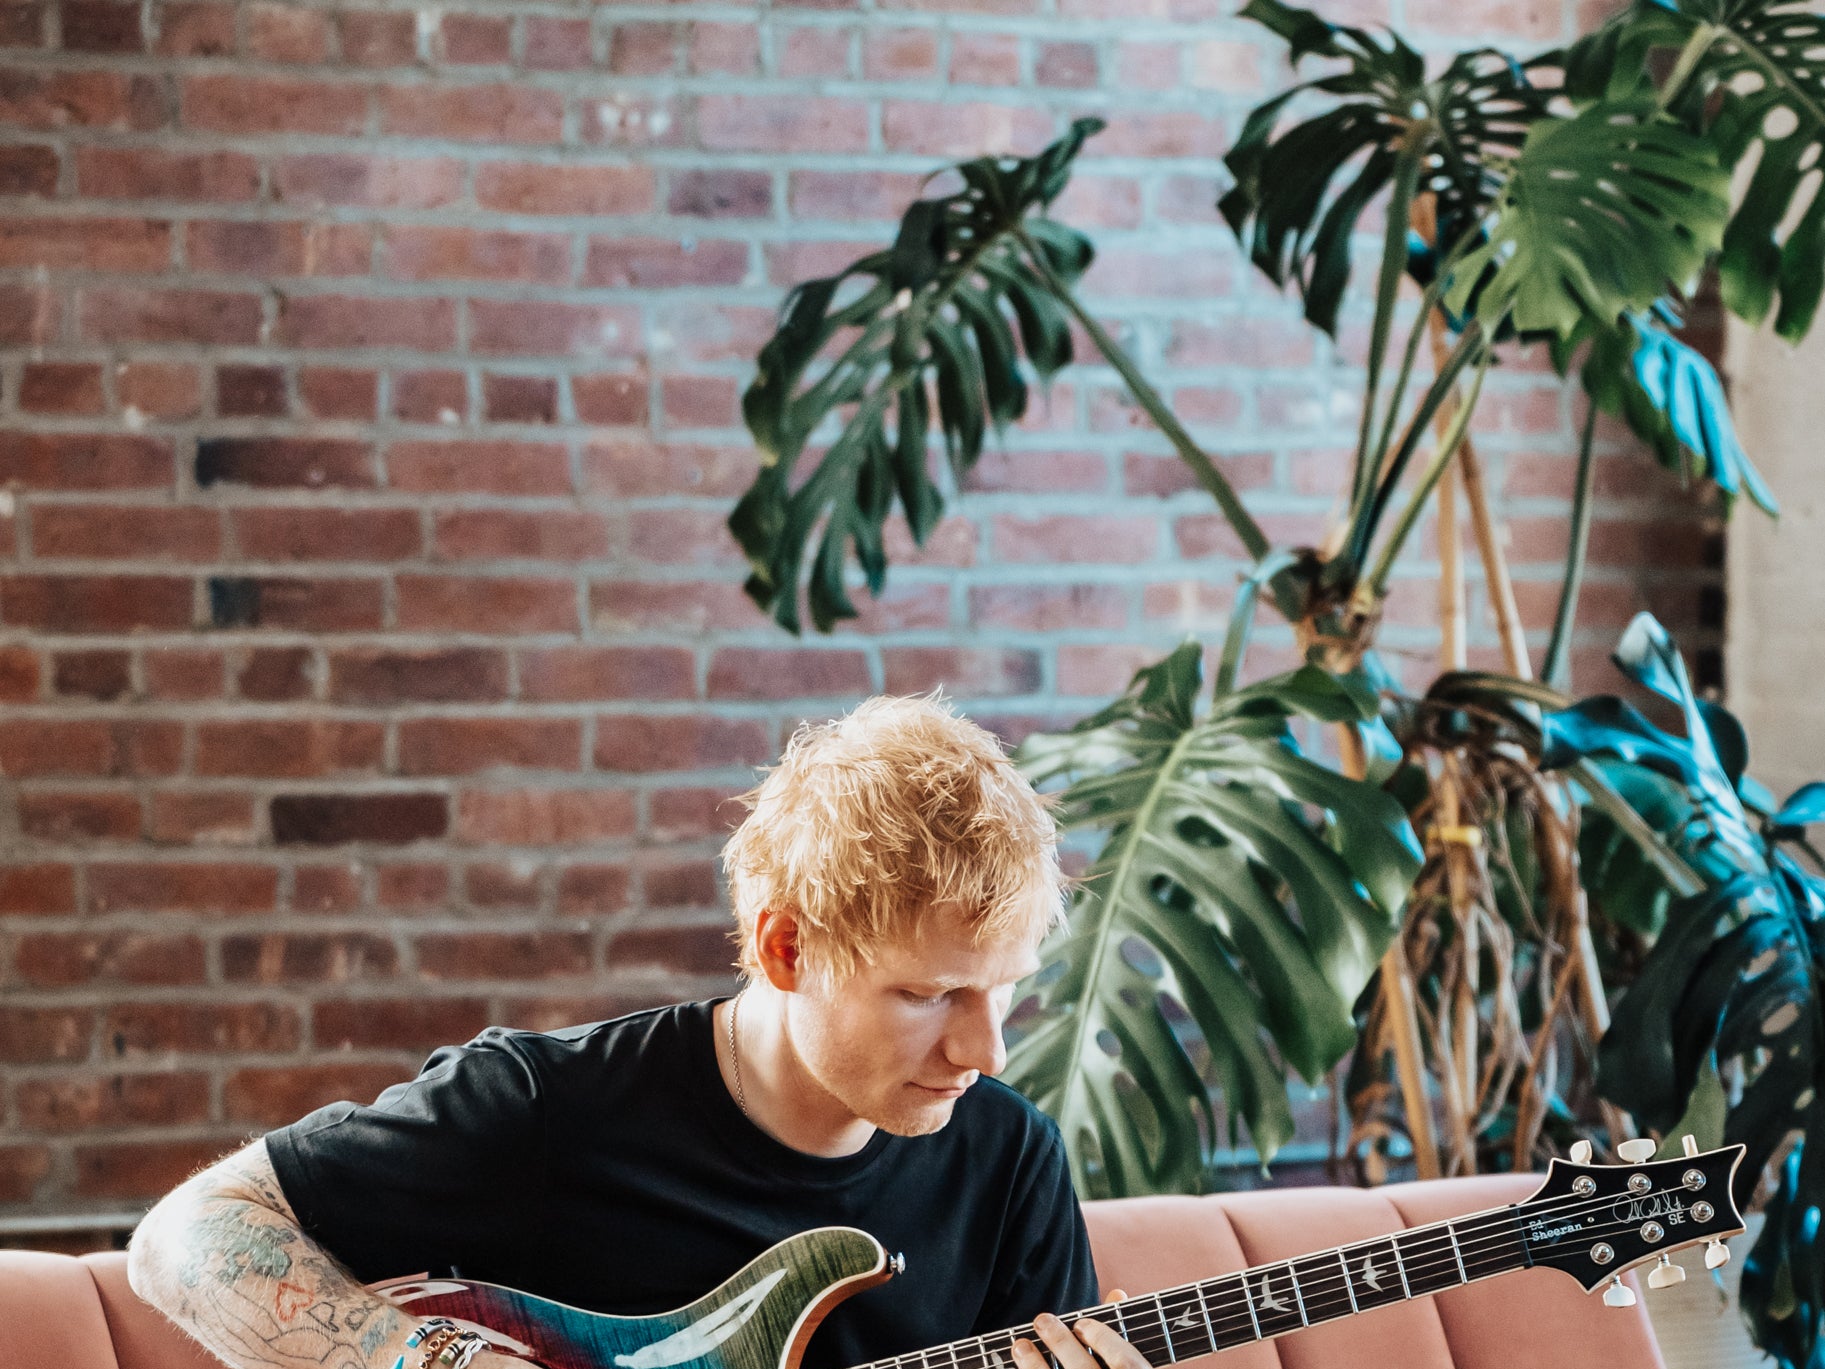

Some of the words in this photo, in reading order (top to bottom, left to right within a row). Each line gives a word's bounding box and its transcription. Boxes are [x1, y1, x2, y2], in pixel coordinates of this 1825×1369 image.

[1529, 1219, 1545, 1231] Ed
[1668, 1211, 1686, 1226] SE
[1532, 1223, 1583, 1242] Sheeran
